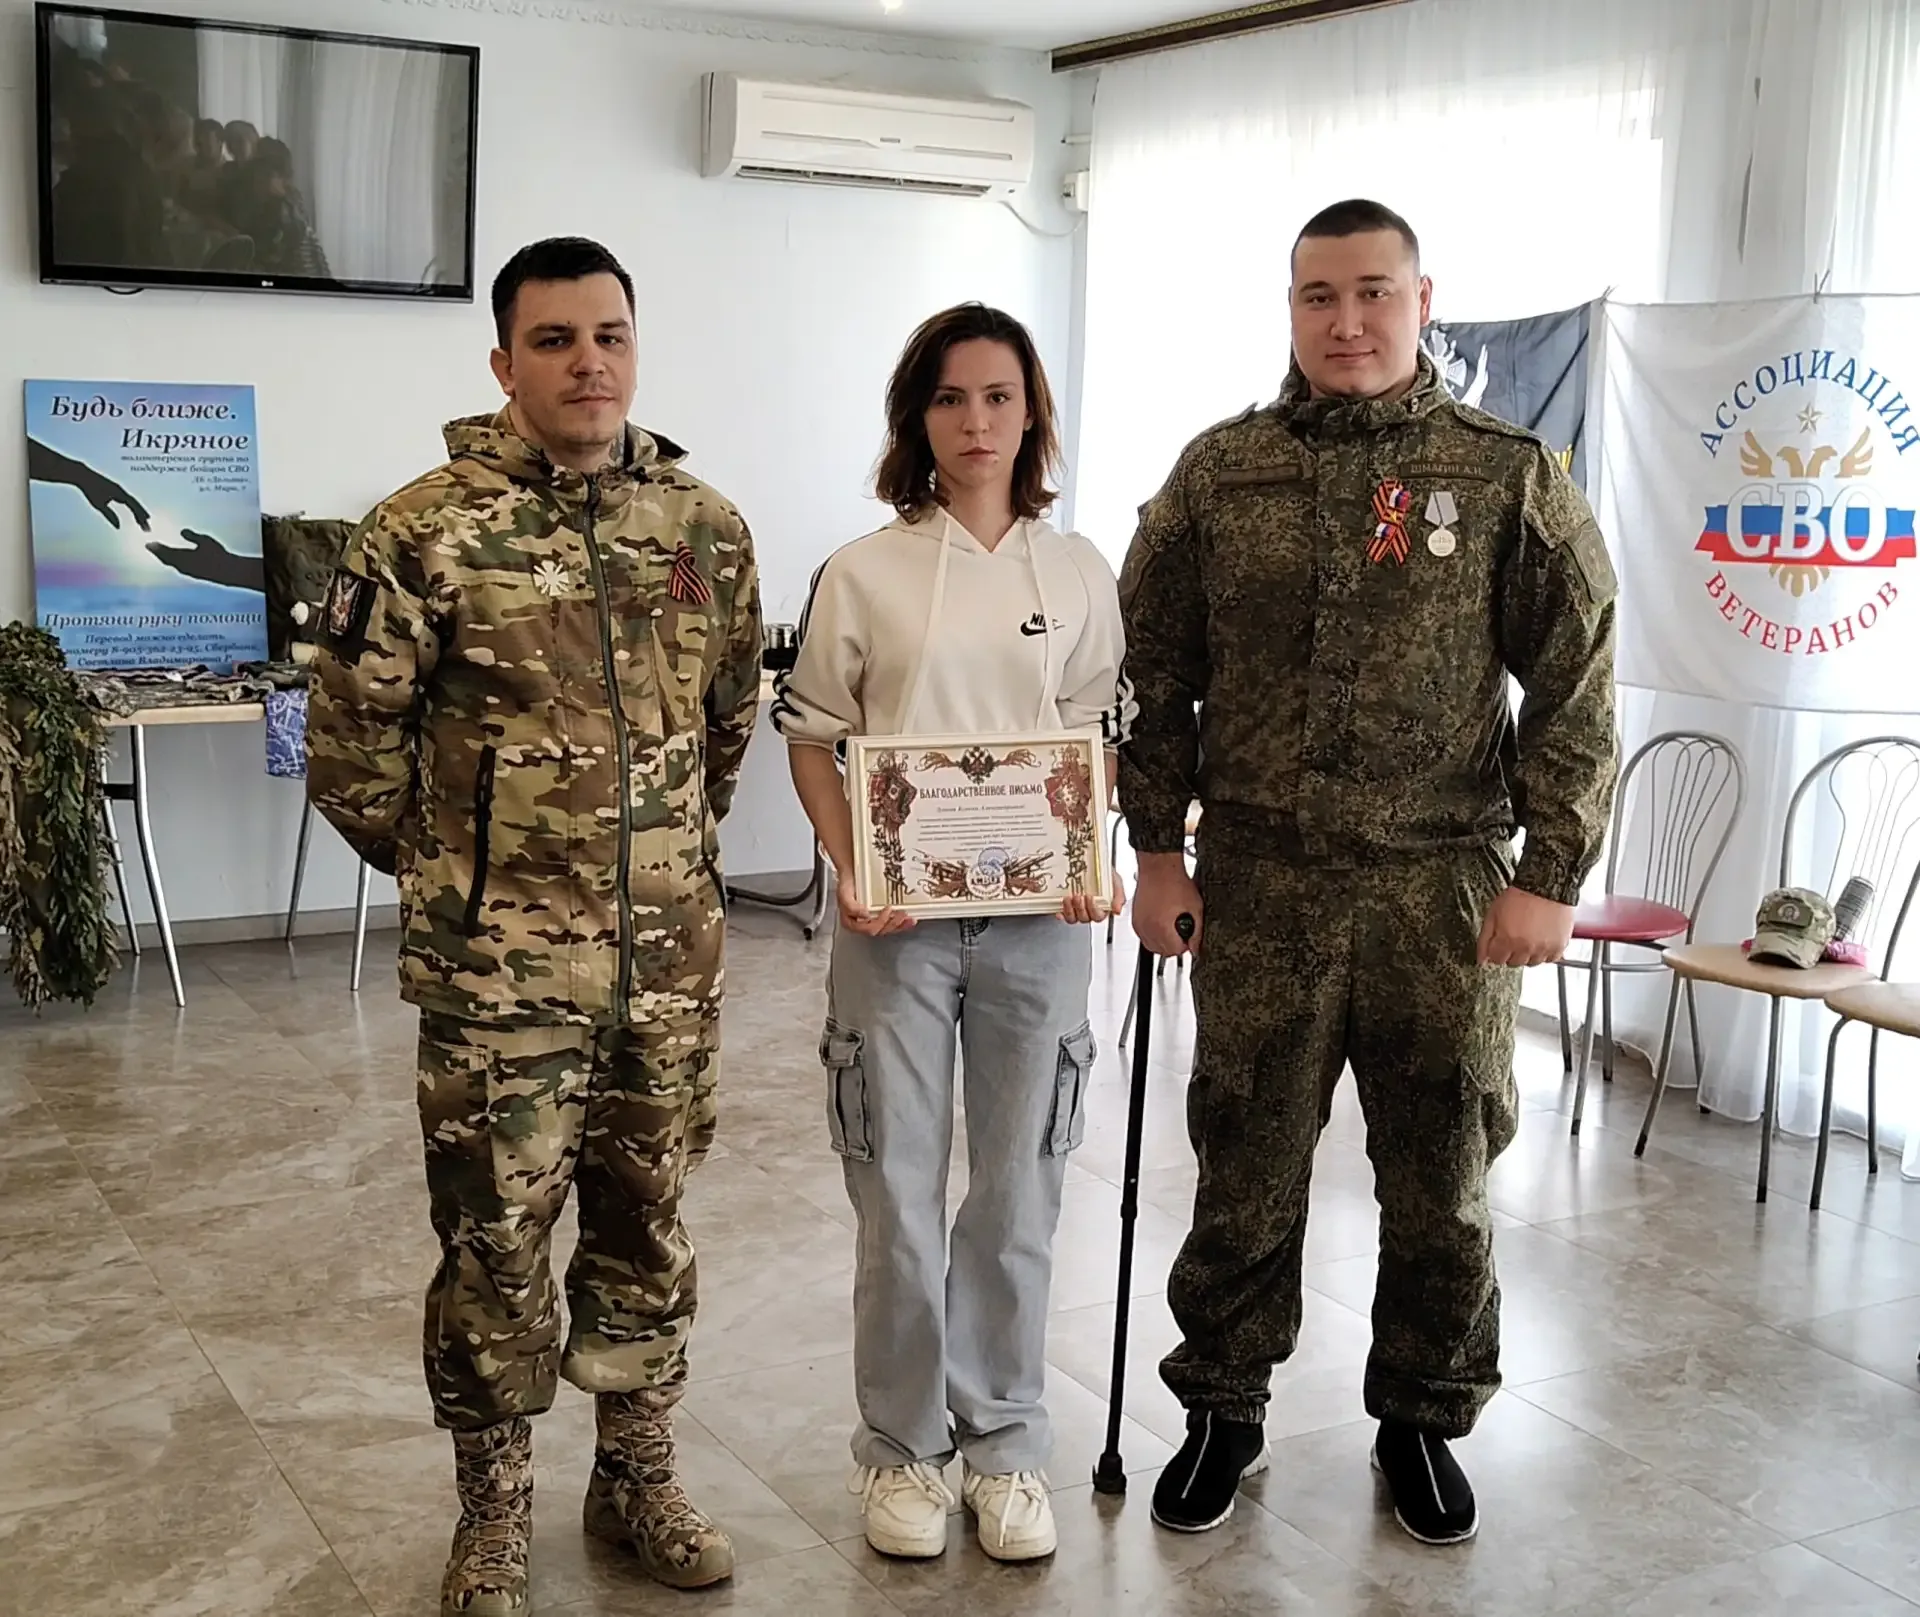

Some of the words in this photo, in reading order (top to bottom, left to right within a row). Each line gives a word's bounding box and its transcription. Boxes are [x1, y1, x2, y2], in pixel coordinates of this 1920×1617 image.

[51, 395, 123, 422] Будь
[131, 397, 237, 419] ближе.
[1700, 349, 1920, 458] АССОЦИАЦИЯ
[120, 428, 249, 453] Икряное
[228, 465, 250, 473] СВО
[1725, 482, 1889, 564] СВО
[45, 613, 133, 629] Протяни
[137, 613, 183, 628] руку
[187, 612, 262, 626] помощи
[1705, 570, 1899, 655] ВЕТЕРАНОВ
[919, 785, 1006, 799] БЛАГОДАРСТВЕННОЕ
[1009, 783, 1043, 796] ПИСЬМО
